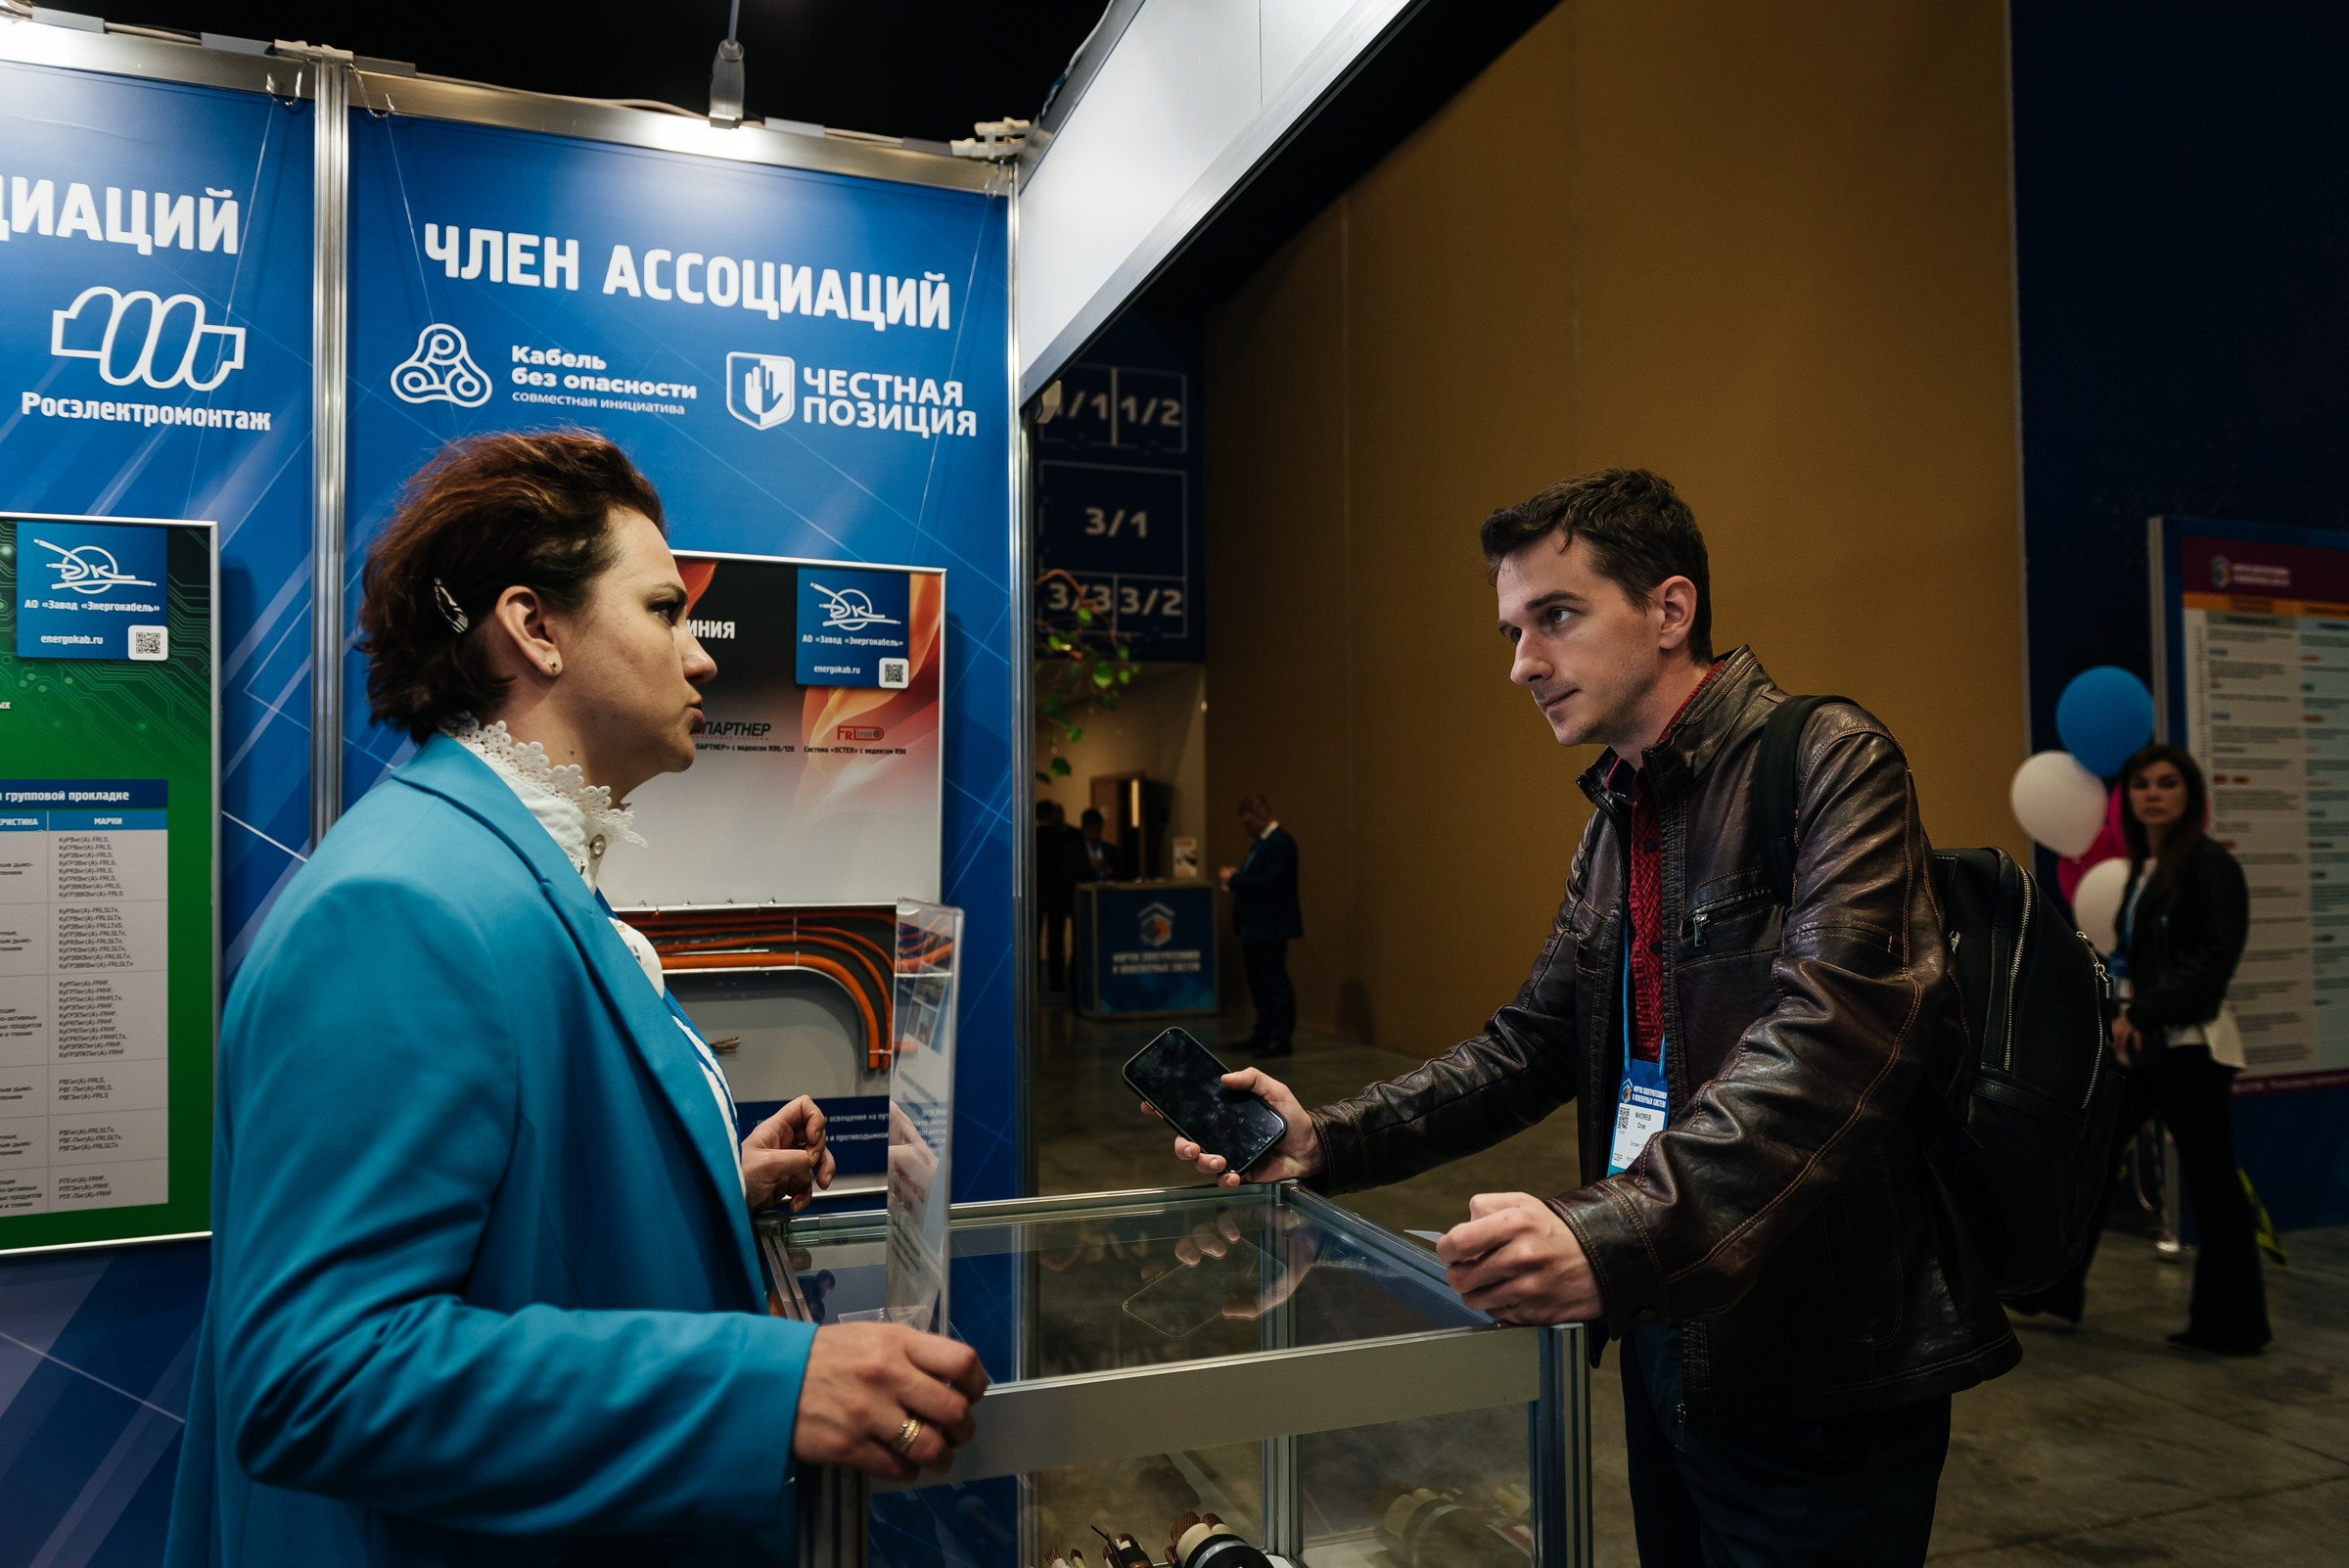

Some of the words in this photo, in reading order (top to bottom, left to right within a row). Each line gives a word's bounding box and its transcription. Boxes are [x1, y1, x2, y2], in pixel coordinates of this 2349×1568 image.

[0, 175, 238, 255] ИАЦИЙ
[424, 222, 579, 292] ЧЛЕН
[602, 244, 951, 332] АССОЦИАЦИЙ
[511, 345, 607, 371] Кабель
[511, 367, 558, 389] без
[563, 373, 698, 399] опасности
[803, 366, 964, 407] ЧЕСТНАЯ
[22, 392, 271, 431] Росэлектромонтаж
[512, 392, 598, 412] совместная
[600, 396, 685, 415] инициатива
[803, 397, 977, 439] ПОЗИЦИЯ
[1120, 395, 1181, 427] 1/2
[1084, 507, 1147, 537] 3/1
[24, 599, 38, 609] АО
[42, 600, 78, 611] «Завод
[1119, 586, 1182, 616] 3/2
[40, 634, 104, 645] energokab.ru
[803, 634, 812, 643] АО
[815, 635, 843, 645] «Завод
[813, 665, 860, 674] energokab.ru
[702, 721, 771, 736] ПАРТНЕР
[5, 791, 65, 803] групповой
[69, 791, 130, 803] прокладке
